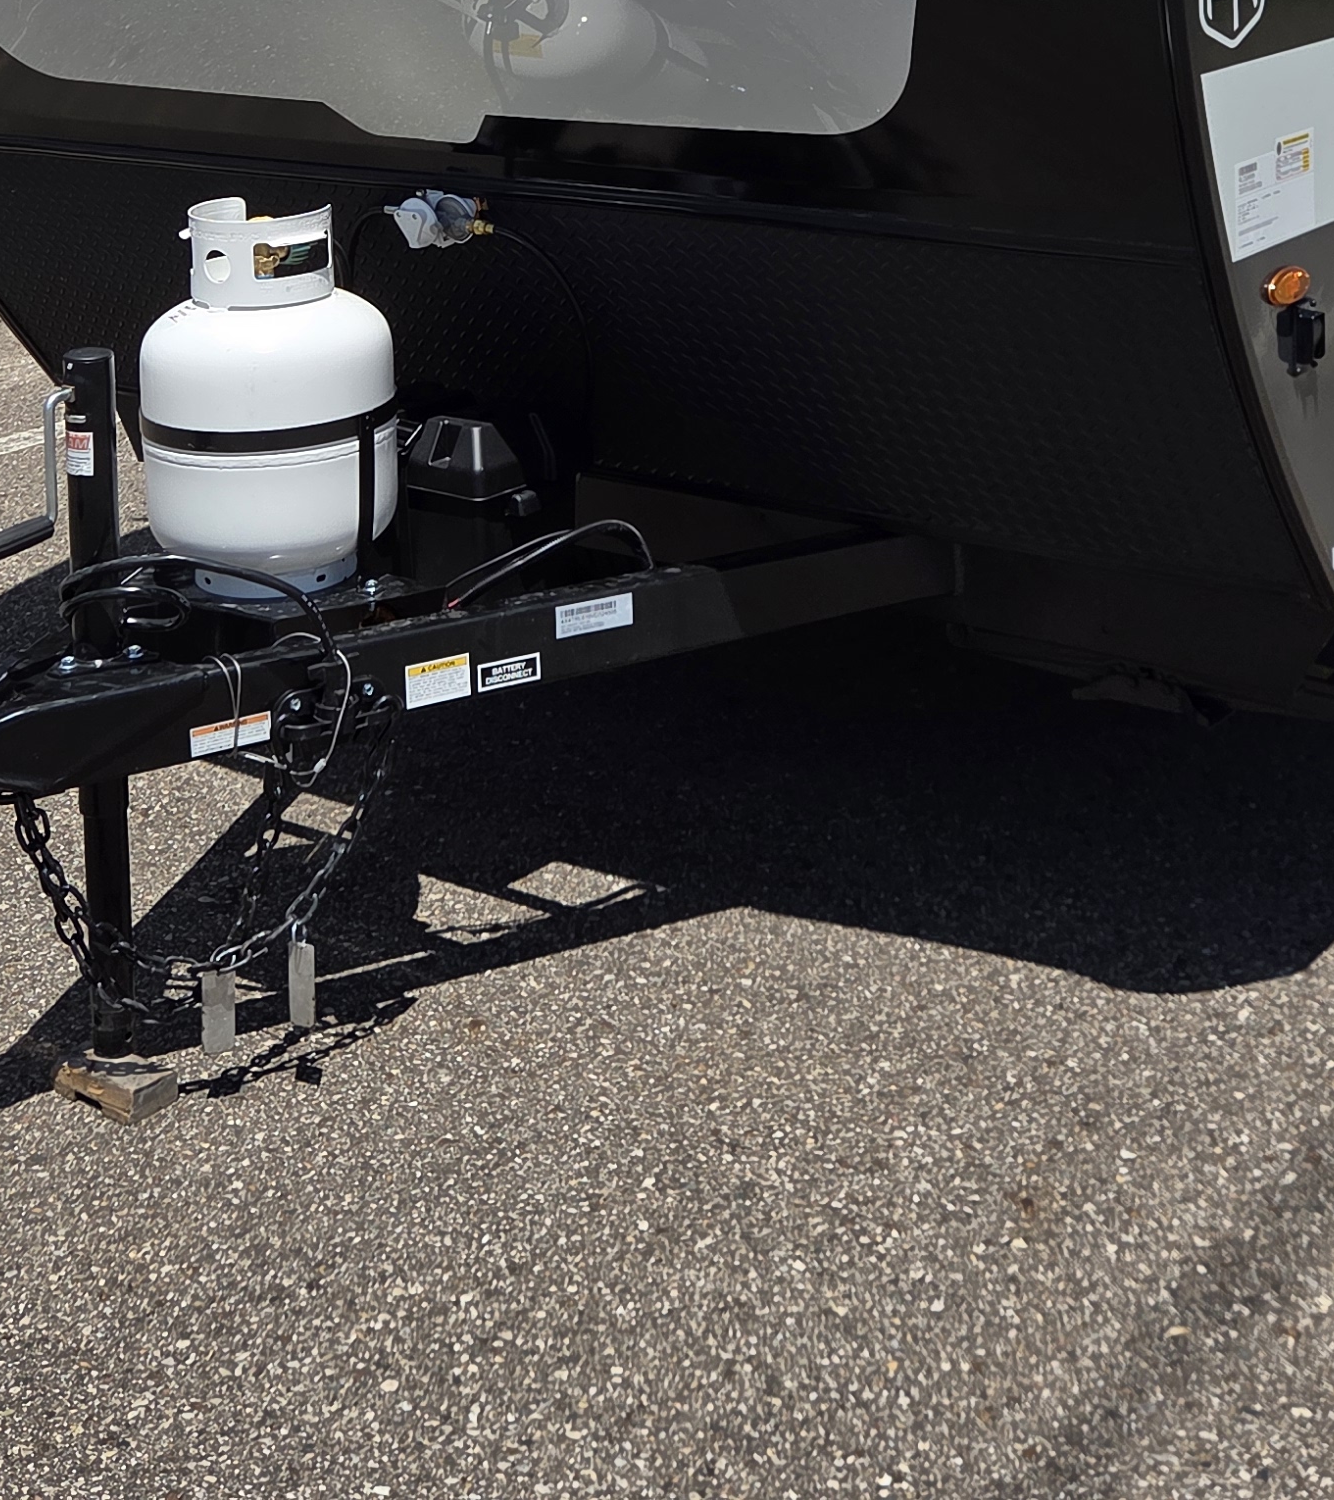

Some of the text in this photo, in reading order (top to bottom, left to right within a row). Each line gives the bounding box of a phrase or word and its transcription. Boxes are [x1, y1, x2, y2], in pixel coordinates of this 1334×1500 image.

[427, 660, 456, 672] CAUTION
[491, 661, 527, 676] BATTERY
[485, 667, 534, 685] DISCONNECT
